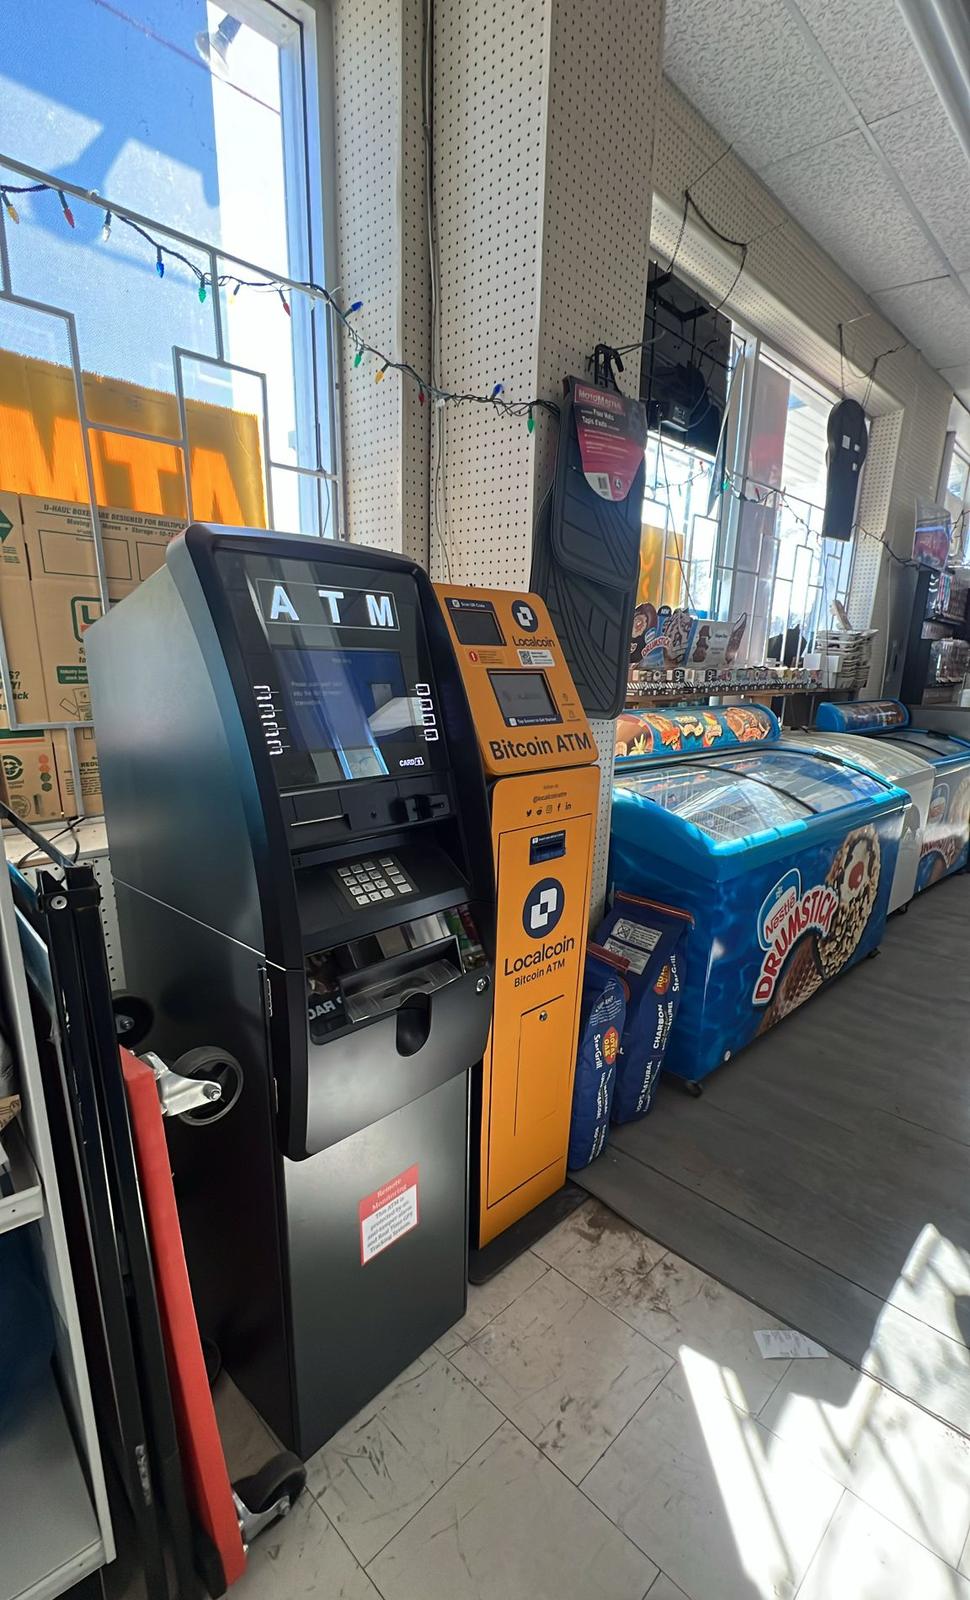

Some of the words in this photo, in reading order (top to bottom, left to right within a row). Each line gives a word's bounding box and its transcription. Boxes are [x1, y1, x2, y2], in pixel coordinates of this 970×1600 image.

[111, 513, 143, 524] DESIGNED
[144, 518, 157, 526] FOR
[270, 585, 394, 627] ATM
[512, 636, 555, 647] Localcoin
[489, 736, 553, 760] Bitcoin
[556, 732, 592, 752] ATM
[504, 936, 575, 976] Localcoin
[755, 890, 838, 999] DRUMSTICK
[514, 968, 545, 987] Bitcoin
[546, 958, 565, 974] ATM
[653, 1004, 664, 1049] CHARBON
[594, 1034, 602, 1069] StarGrill
[641, 1060, 652, 1093] NATURAL
[372, 1184, 407, 1209] Monitoring
[377, 1178, 402, 1198] Remote
